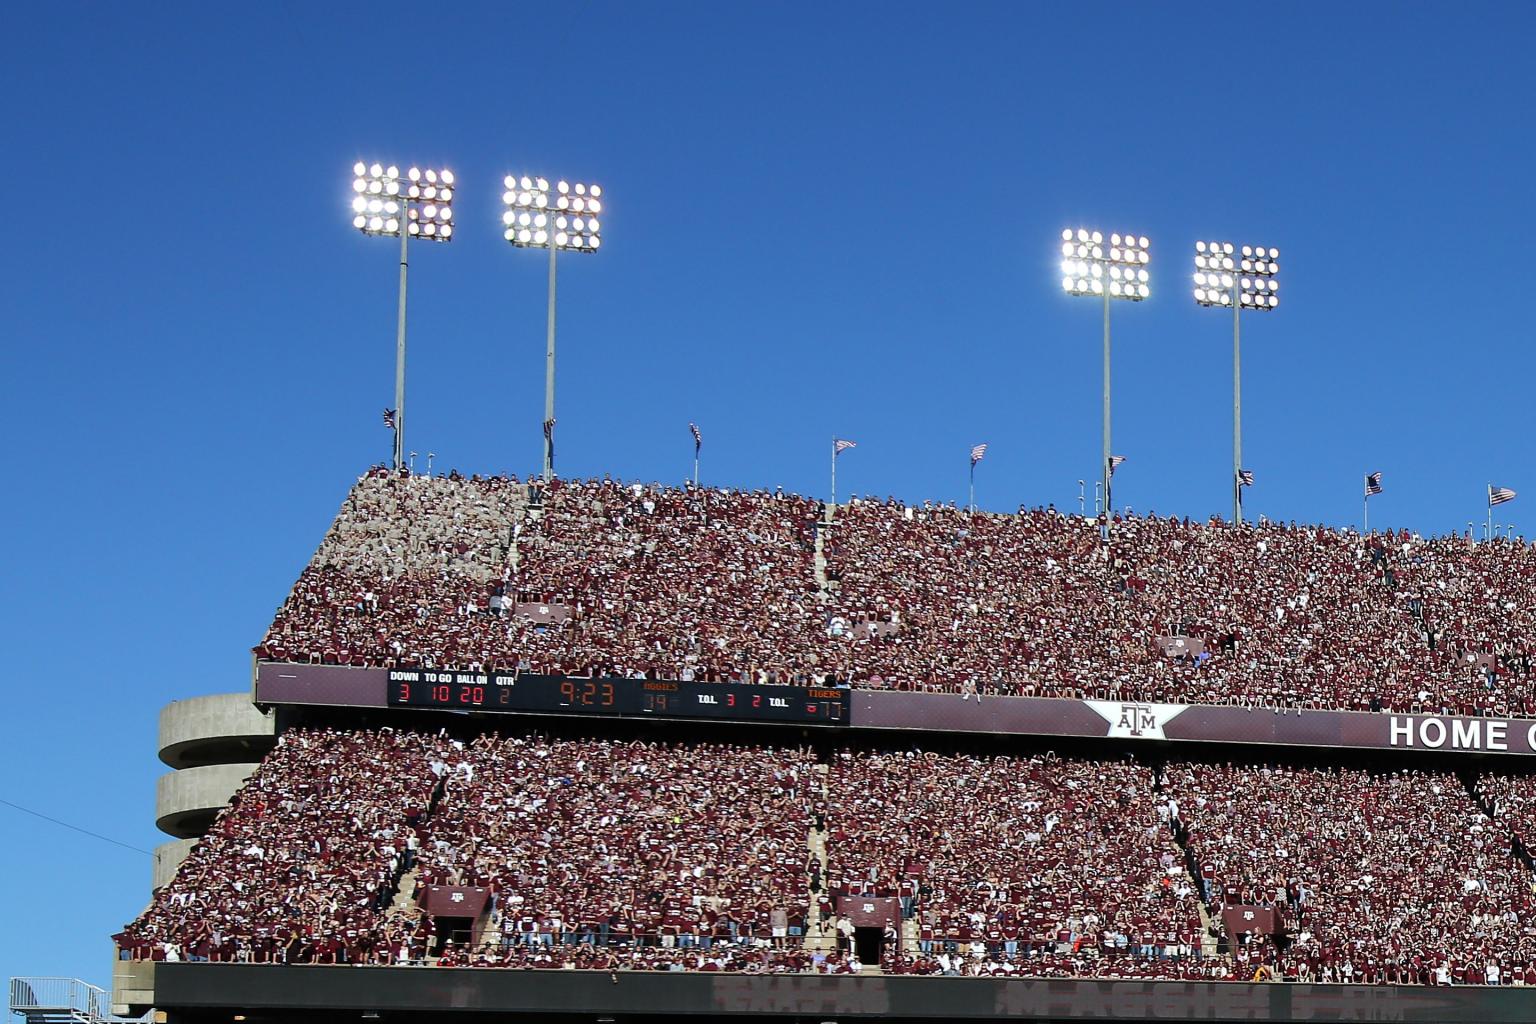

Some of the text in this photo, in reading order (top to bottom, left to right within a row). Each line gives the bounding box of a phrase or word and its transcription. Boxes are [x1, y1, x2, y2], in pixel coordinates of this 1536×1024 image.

[390, 671, 419, 682] DOWN
[425, 672, 452, 683] TO GO
[457, 674, 488, 685] BALL ON
[496, 676, 514, 686] QTR
[400, 683, 410, 700] 3
[432, 685, 450, 702] 10
[459, 686, 484, 703] 20
[500, 688, 510, 704] 2
[560, 682, 615, 706] 9:23
[807, 689, 842, 699] TIGERS
[727, 694, 735, 706] 3
[752, 695, 761, 707] 2
[1390, 717, 1508, 750] HOME
